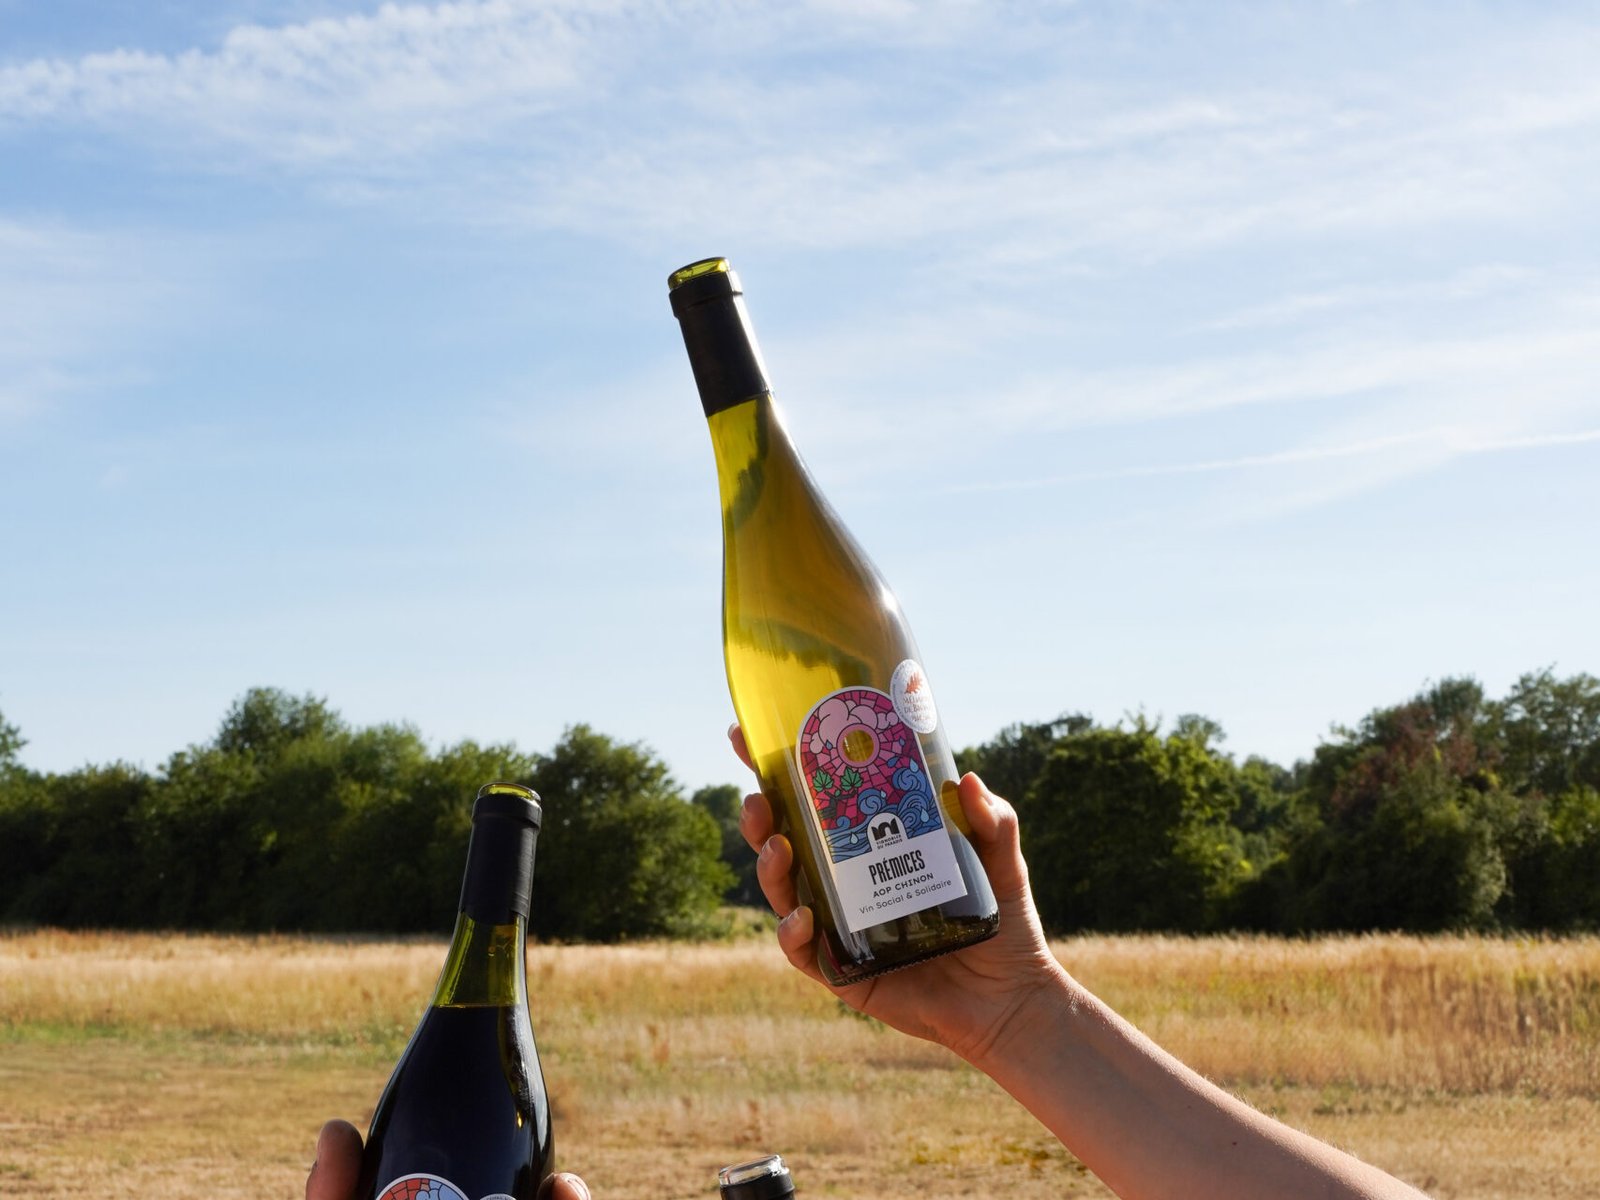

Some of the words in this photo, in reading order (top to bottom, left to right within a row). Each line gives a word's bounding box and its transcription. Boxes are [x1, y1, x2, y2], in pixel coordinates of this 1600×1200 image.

[868, 849, 926, 885] PRÉMICES
[859, 905, 875, 914] Vin
[875, 895, 904, 909] Social
[906, 891, 913, 899] &
[915, 879, 952, 897] Solidaire
[872, 886, 892, 898] AOP
[894, 872, 934, 891] CHINON
